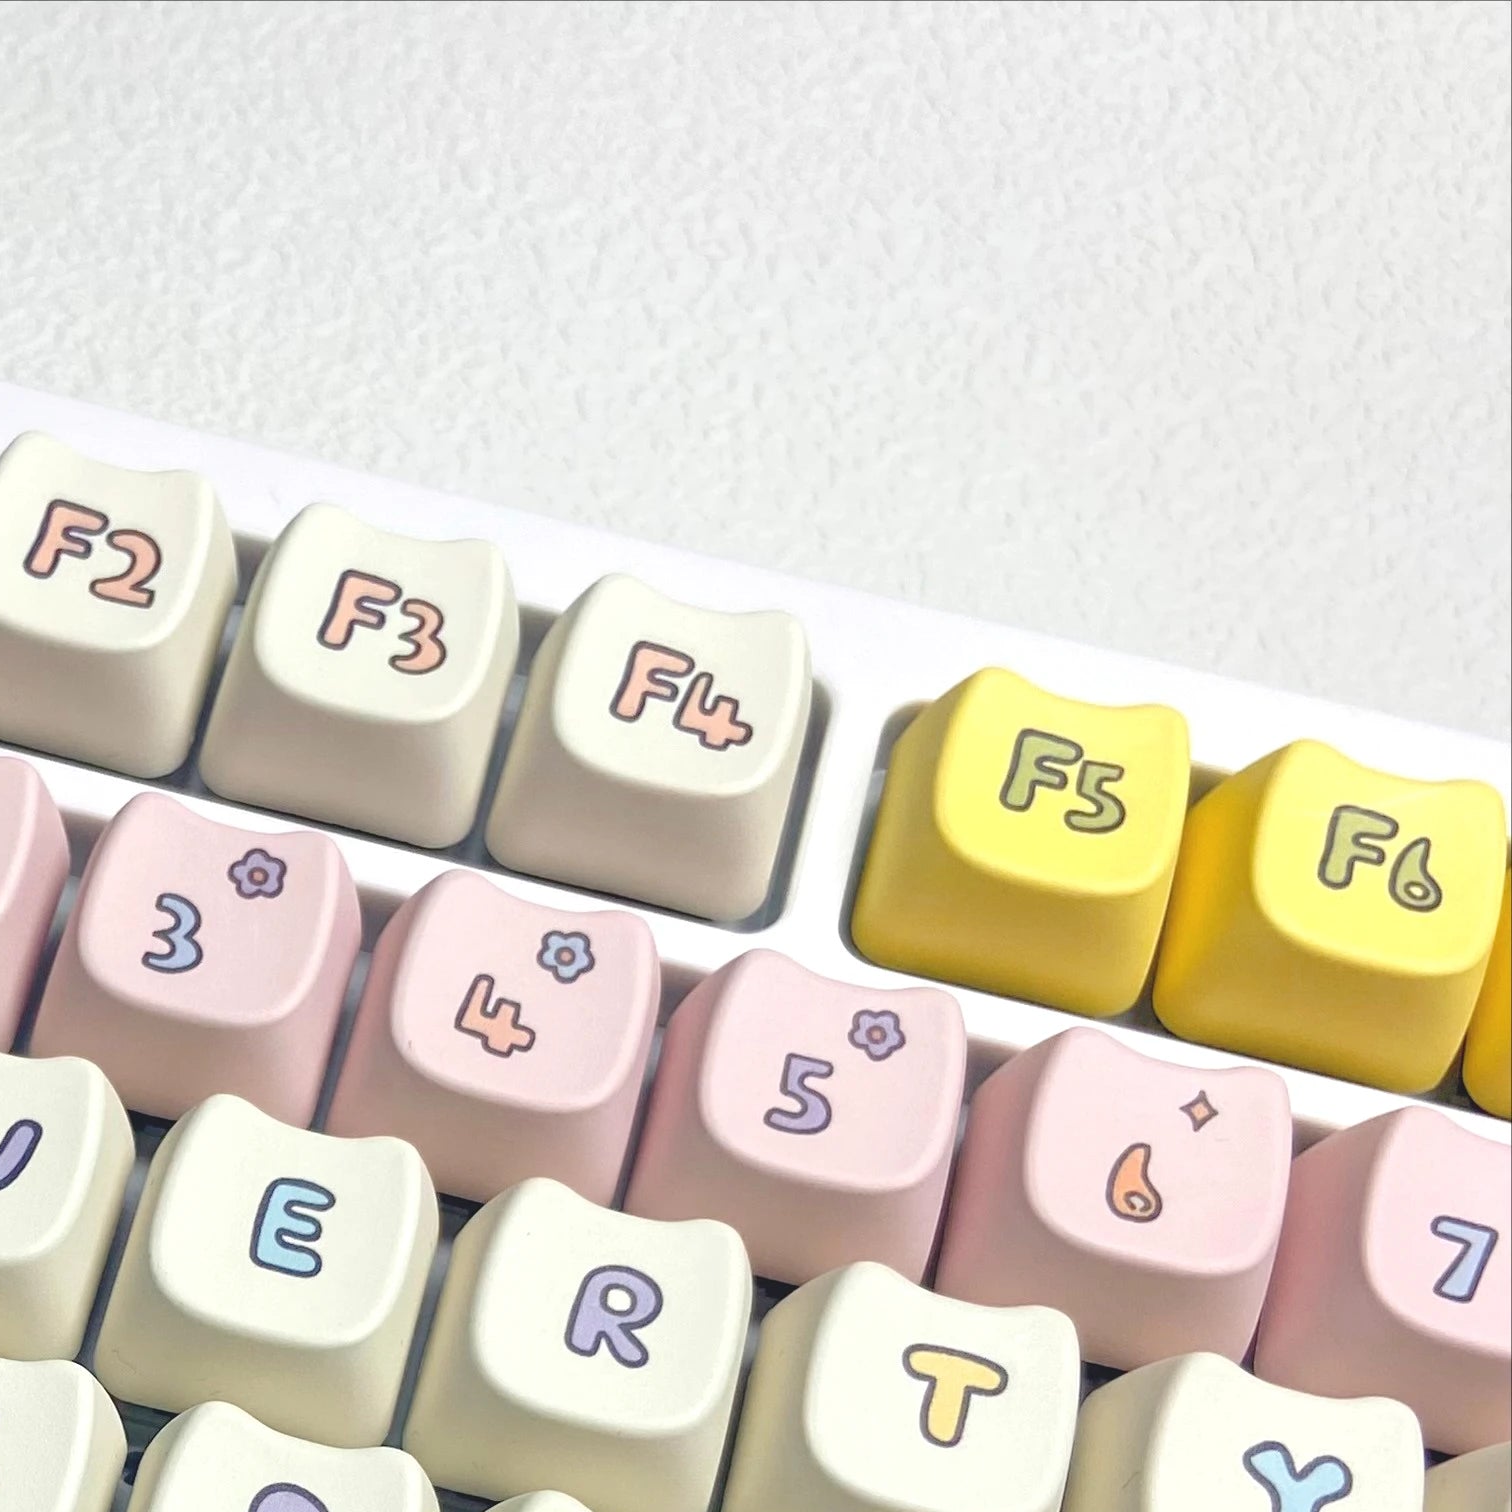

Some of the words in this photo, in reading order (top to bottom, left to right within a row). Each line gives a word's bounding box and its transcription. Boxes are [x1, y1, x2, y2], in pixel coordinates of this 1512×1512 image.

[23, 499, 162, 608] F2
[317, 570, 446, 675] F3
[609, 641, 753, 751] F4
[999, 729, 1126, 833] F5
[1318, 805, 1442, 912] F6
[142, 893, 203, 974] 3
[453, 973, 536, 1058] 4
[764, 1053, 833, 1135] 5
[250, 1178, 336, 1278] E
[1106, 1143, 1162, 1223] 6
[1430, 1215, 1498, 1302] 7
[565, 1265, 663, 1368] R
[903, 1344, 1008, 1448] T
